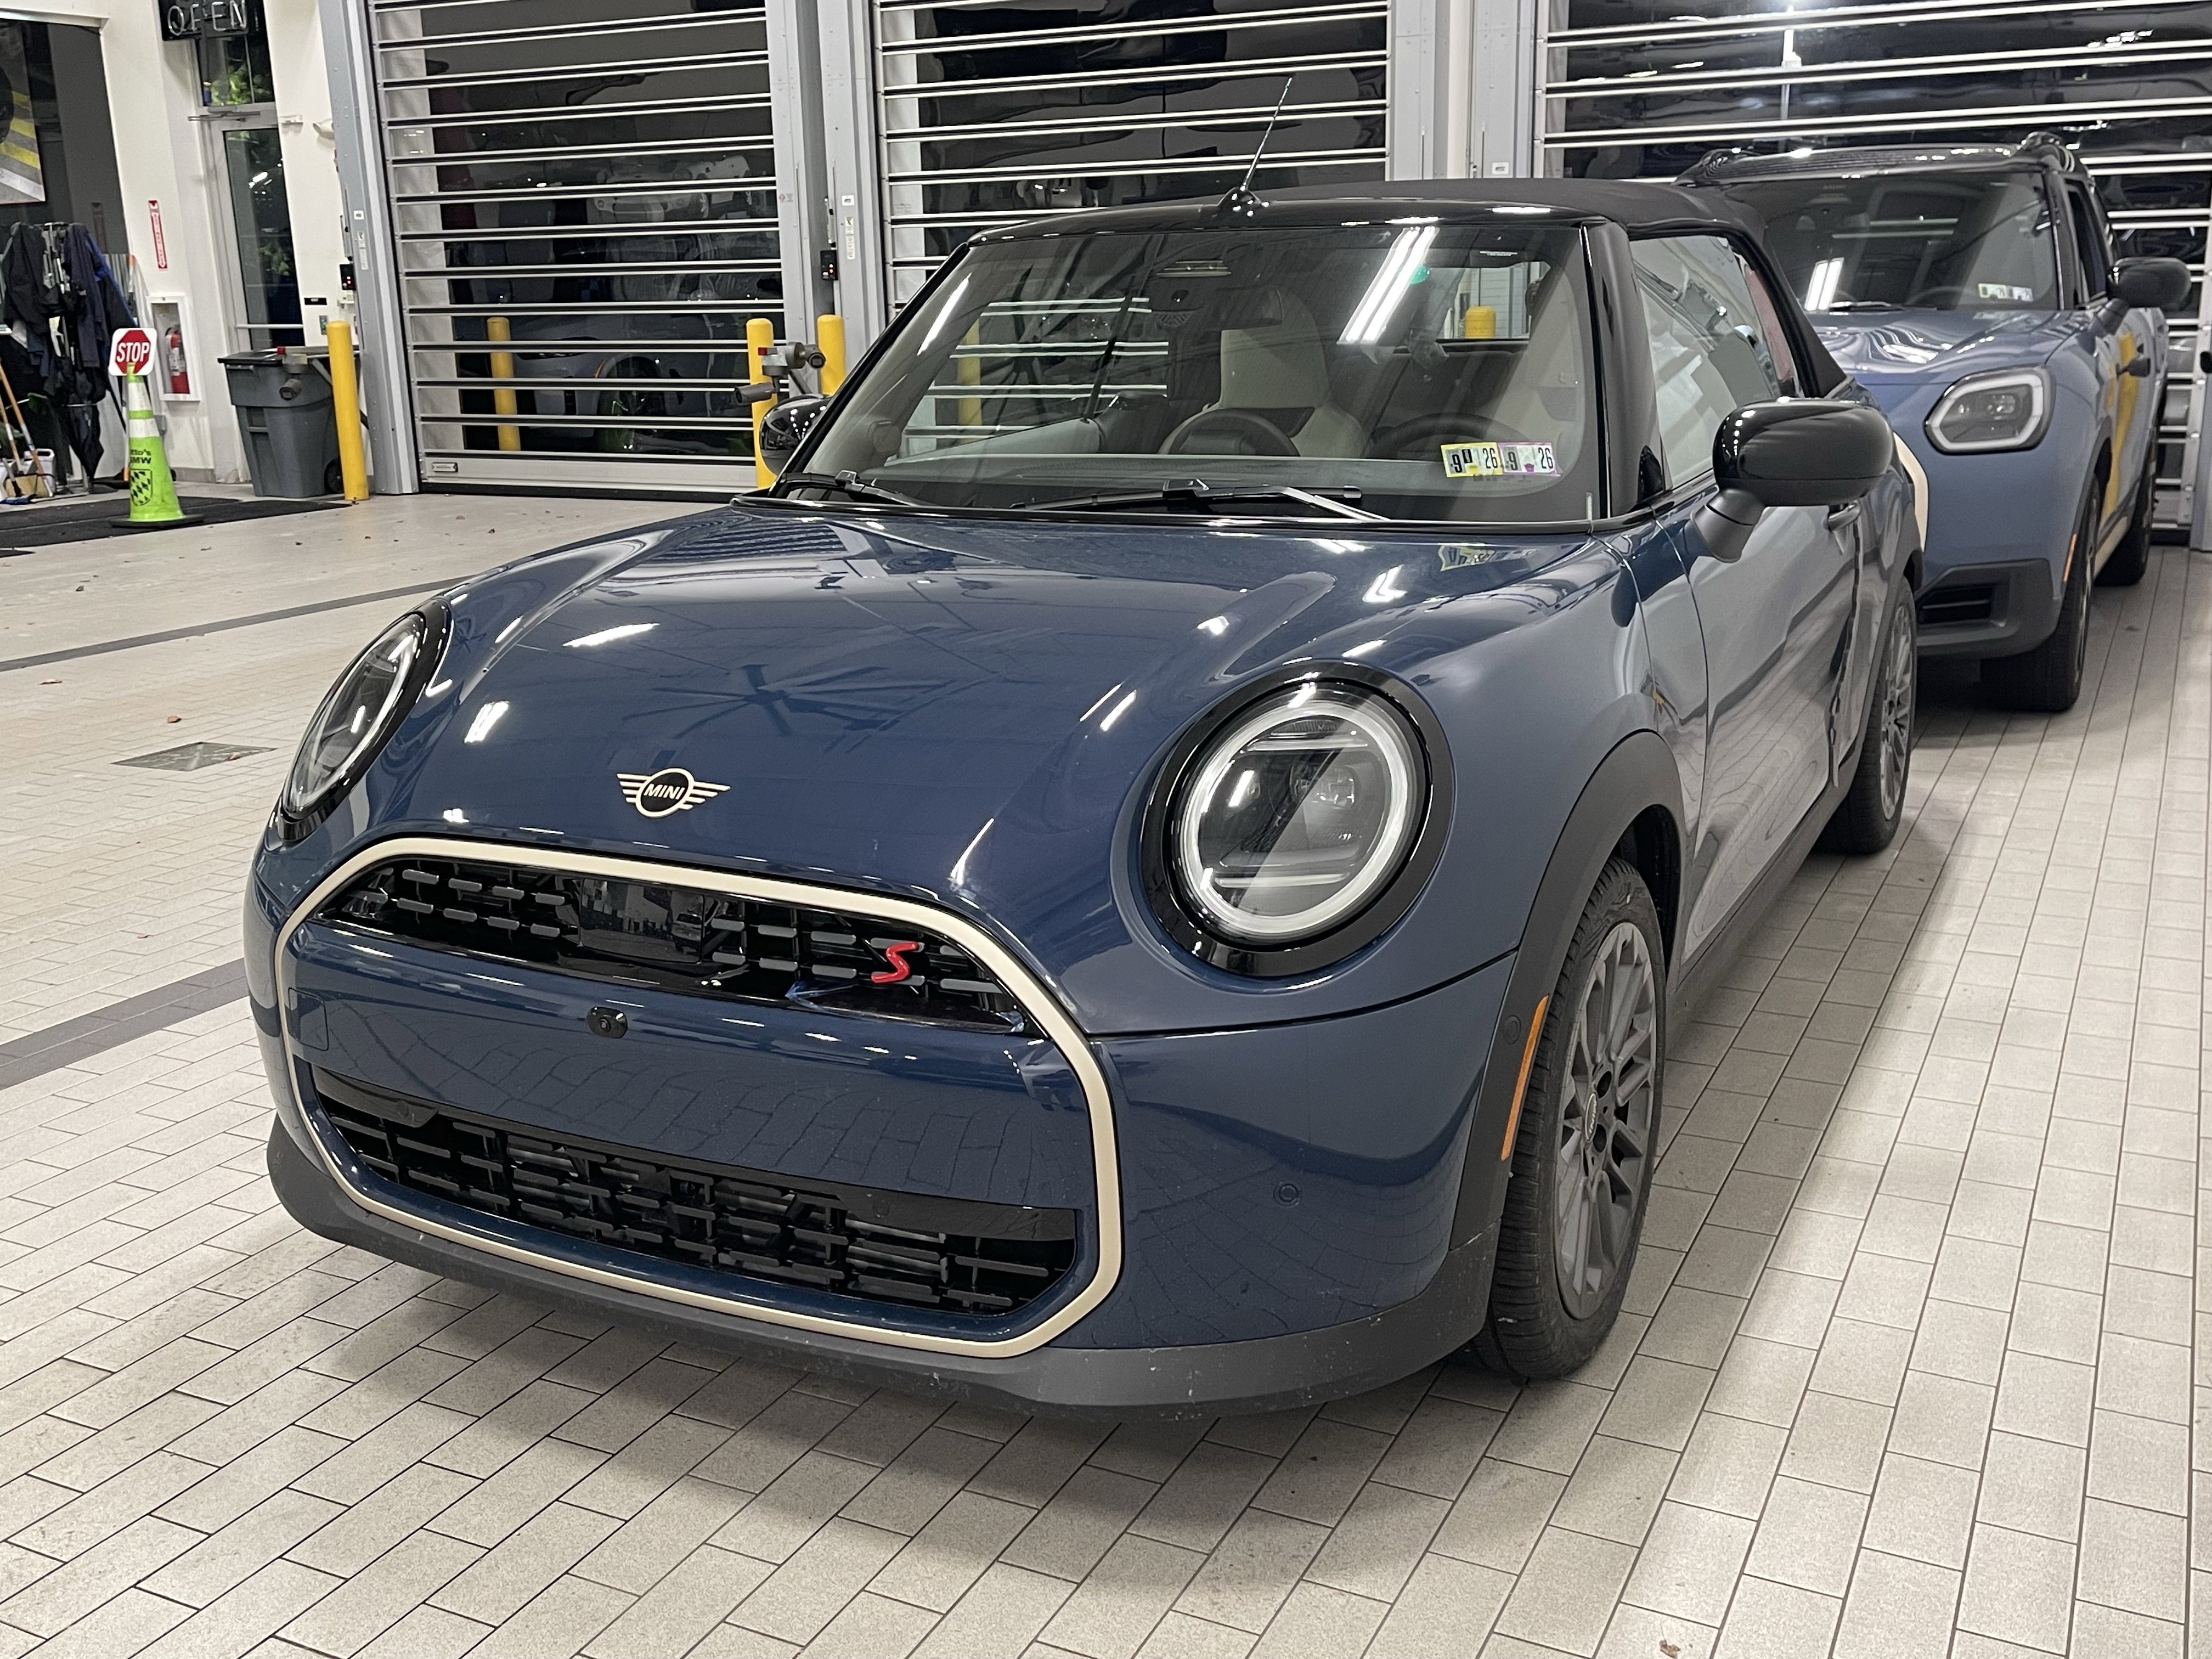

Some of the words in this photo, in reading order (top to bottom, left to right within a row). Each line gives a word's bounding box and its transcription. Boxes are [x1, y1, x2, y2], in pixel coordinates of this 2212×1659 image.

[167, 0, 247, 36] OPEN
[116, 342, 150, 363] STOP
[1451, 454, 1463, 473] 9
[1482, 448, 1498, 469] 26
[1507, 452, 1518, 470] 9
[1538, 447, 1554, 469] 26
[643, 783, 685, 800] MINI
[871, 941, 918, 983] S
